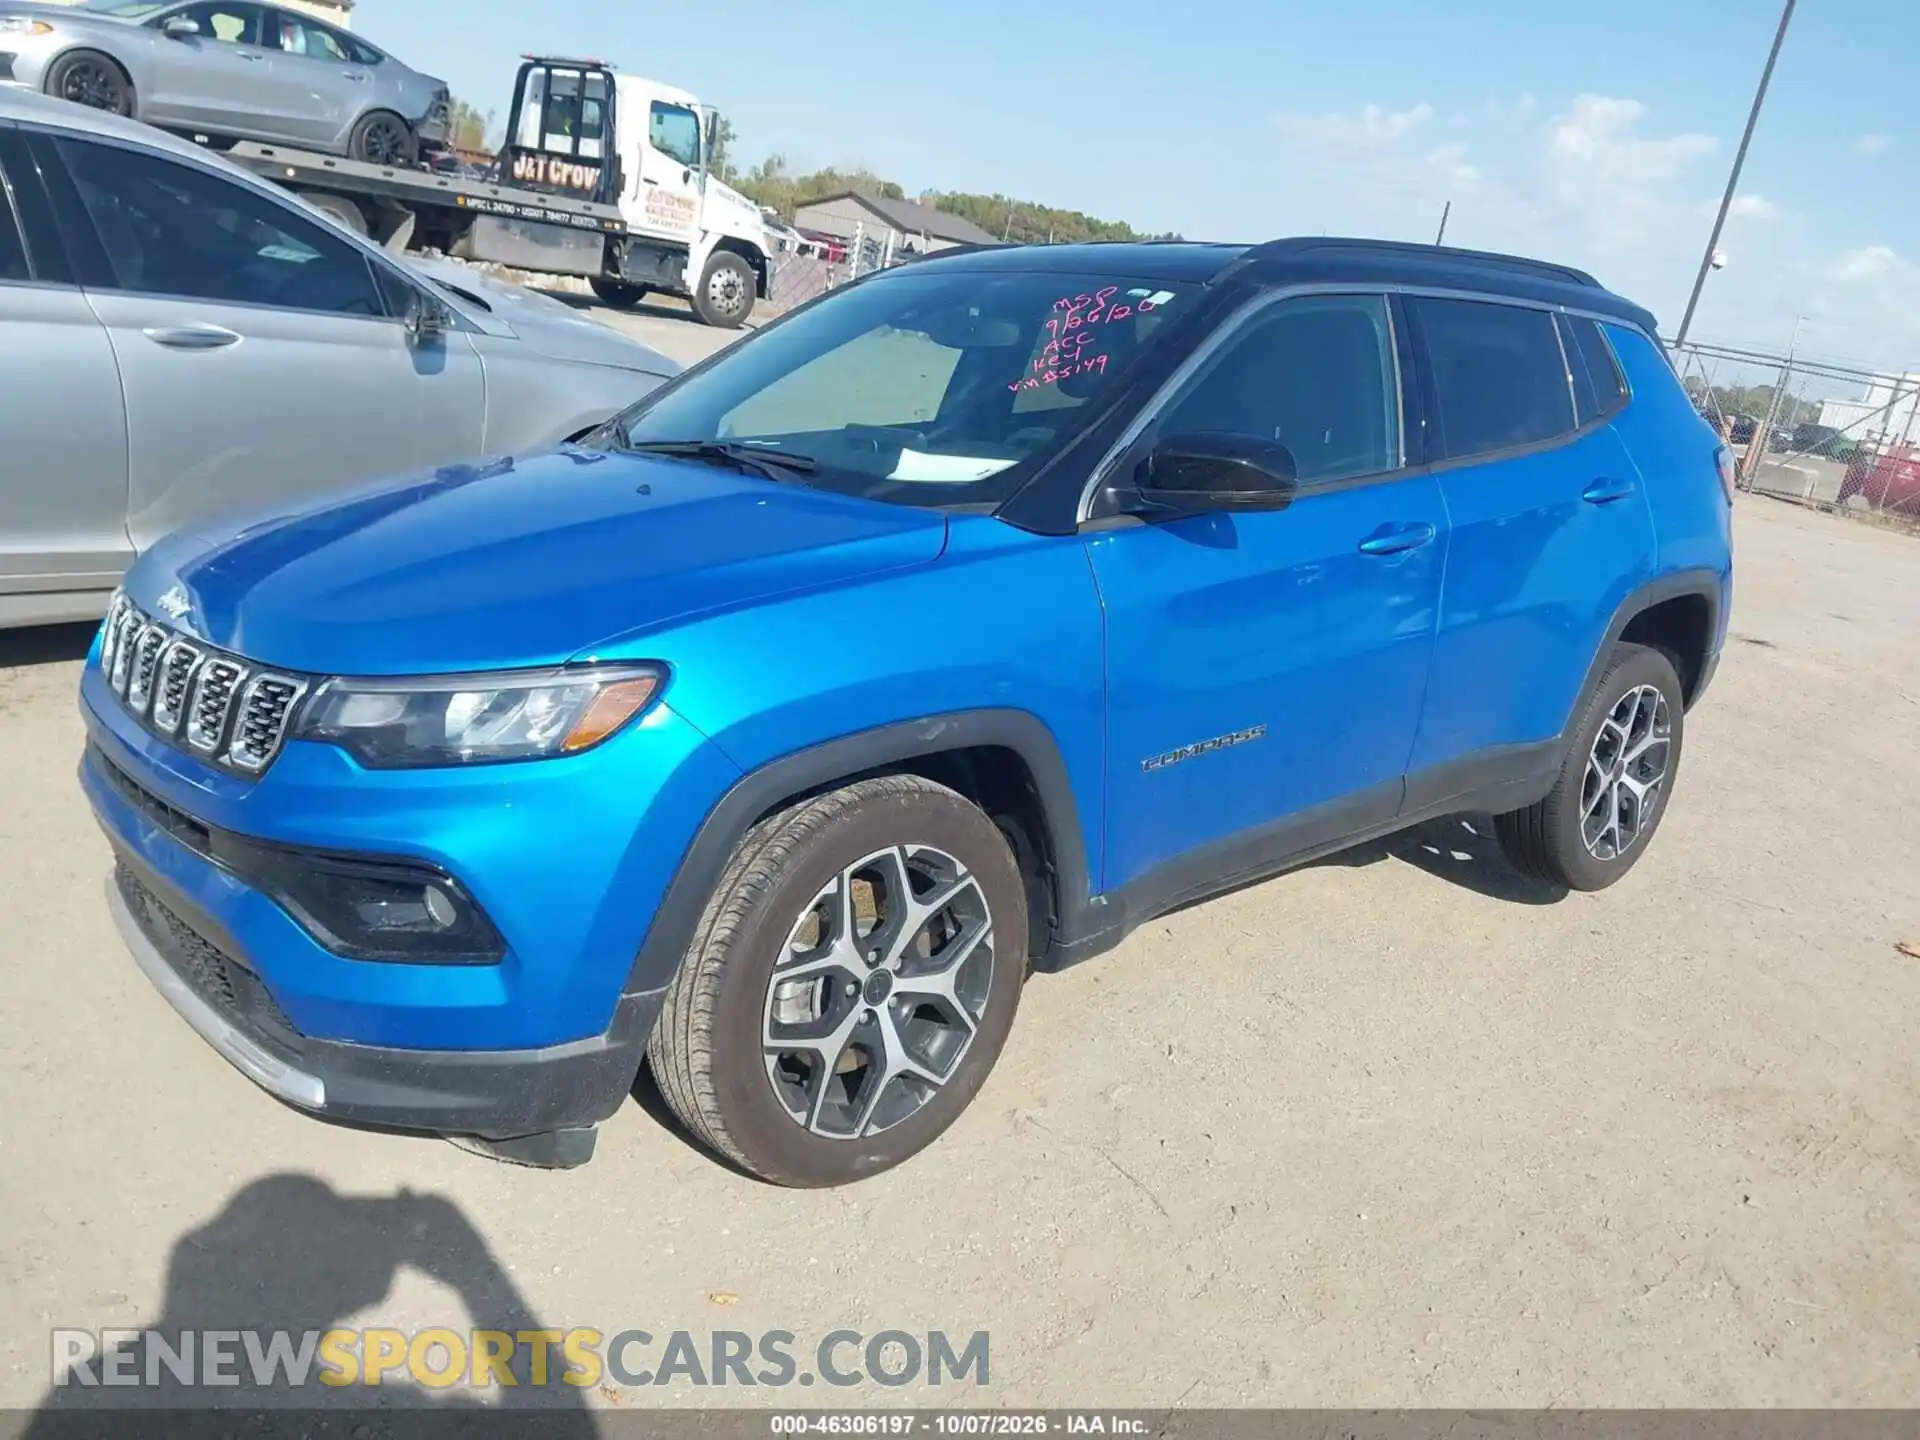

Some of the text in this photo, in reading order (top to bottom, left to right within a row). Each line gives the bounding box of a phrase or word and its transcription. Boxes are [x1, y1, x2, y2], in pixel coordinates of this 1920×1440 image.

[513, 152, 547, 182] J&T
[1043, 332, 1095, 355] ACC
[1141, 723, 1267, 773] COMPASS
